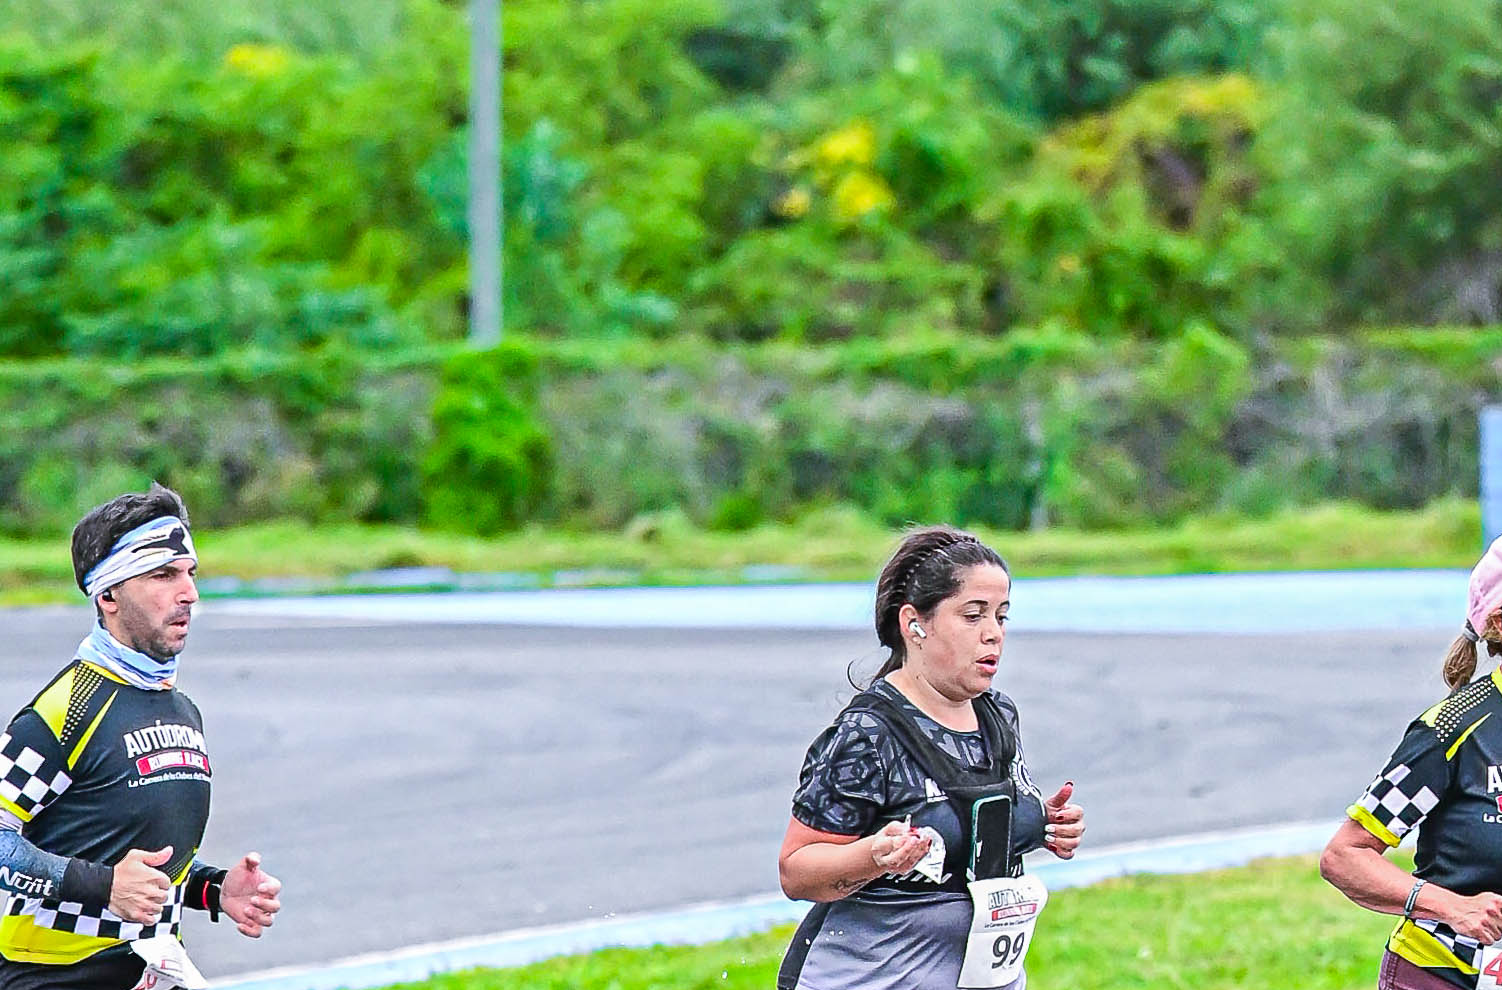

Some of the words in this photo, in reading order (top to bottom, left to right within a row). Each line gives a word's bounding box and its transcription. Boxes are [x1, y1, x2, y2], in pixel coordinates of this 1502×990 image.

[123, 719, 208, 758] AUTÓDROM
[1483, 813, 1495, 823] La
[992, 932, 1025, 969] 99
